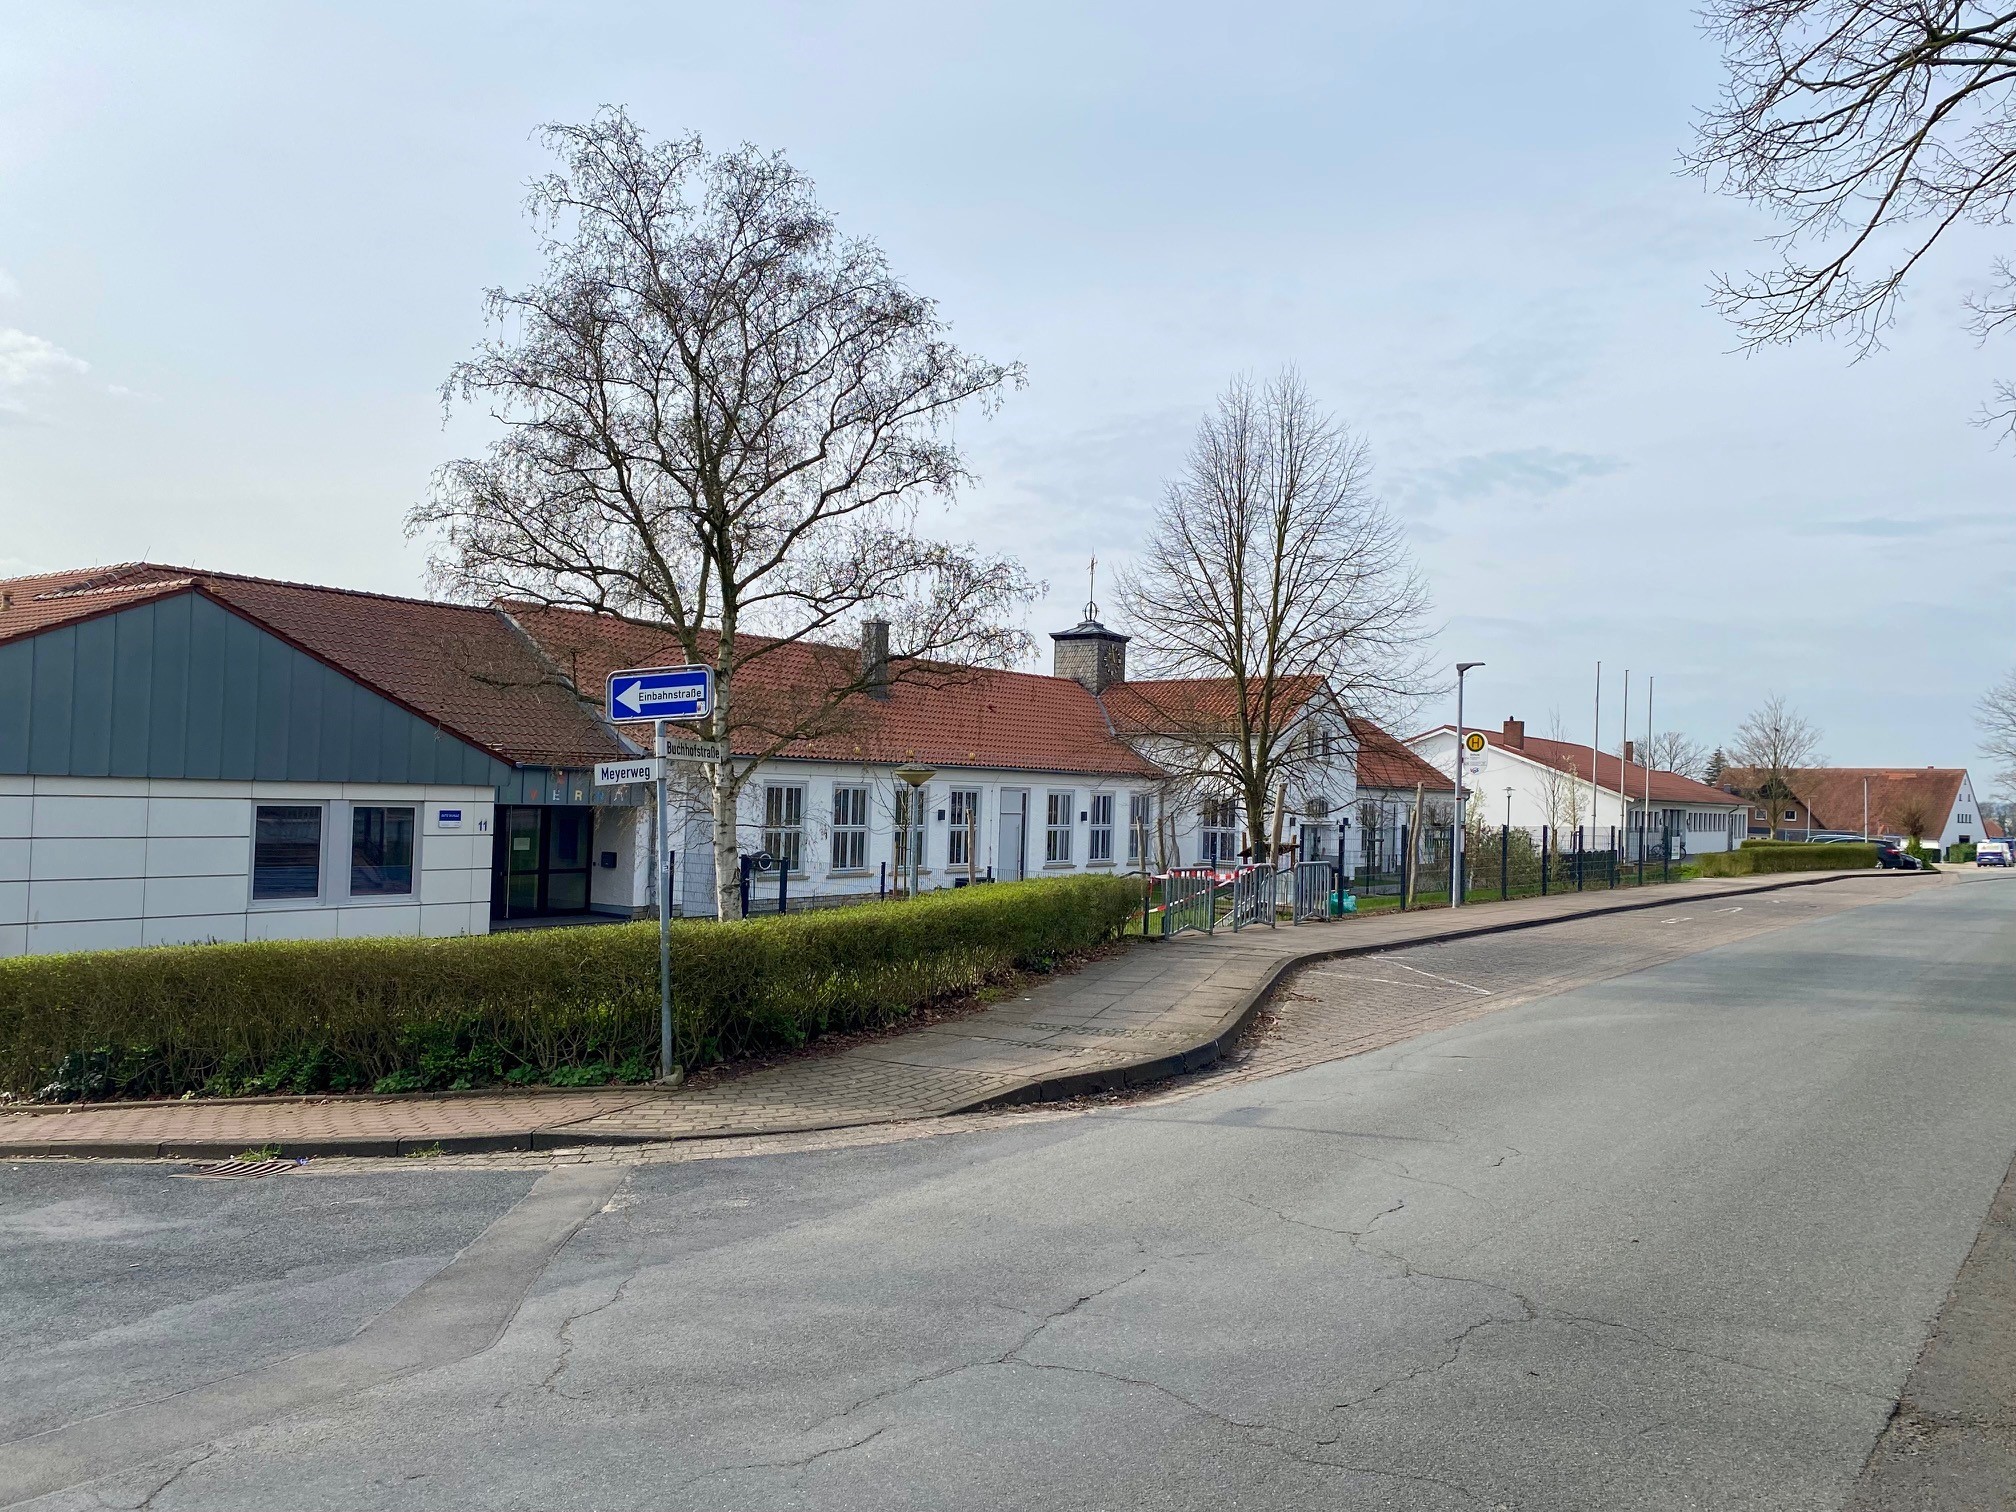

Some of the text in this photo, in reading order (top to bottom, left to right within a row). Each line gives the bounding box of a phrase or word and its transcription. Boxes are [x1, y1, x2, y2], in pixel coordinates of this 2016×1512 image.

[639, 688, 701, 701] Einbahnstraße
[1471, 737, 1480, 748] H
[667, 741, 720, 758] Buchhofstraße
[601, 767, 650, 782] Meyerweg
[478, 820, 487, 831] 11
